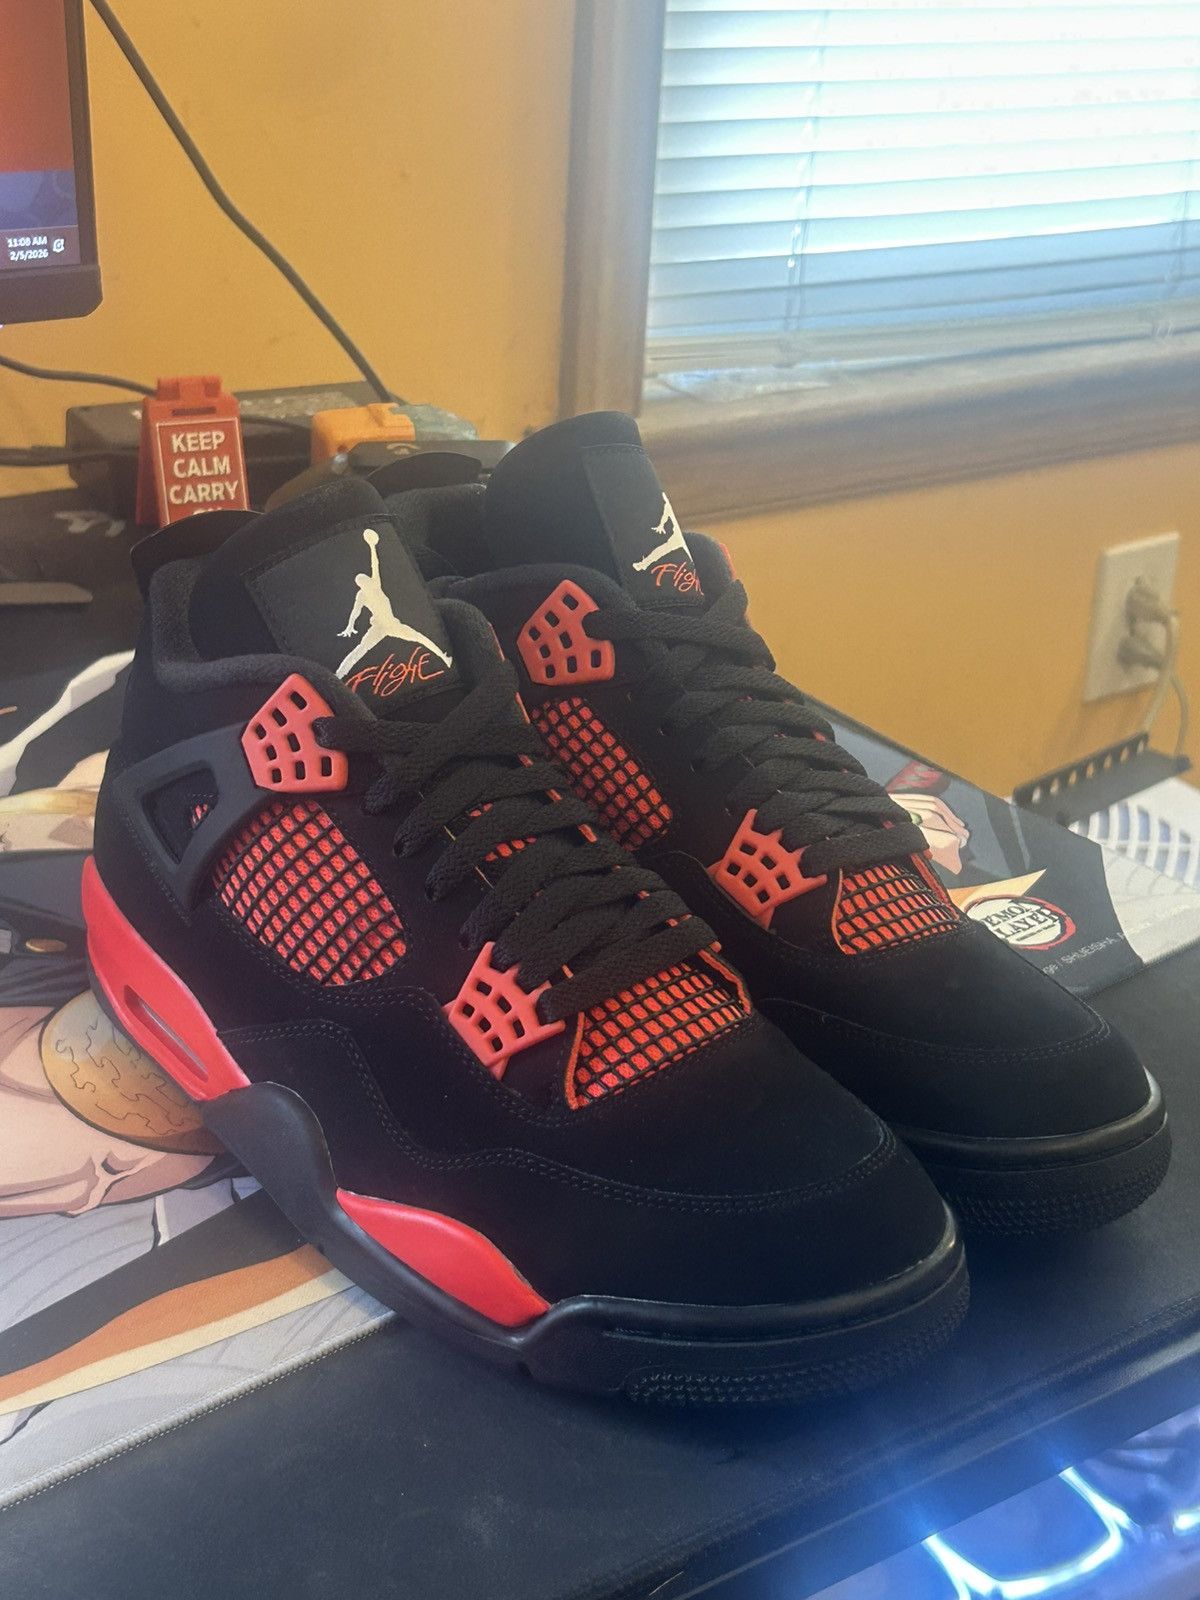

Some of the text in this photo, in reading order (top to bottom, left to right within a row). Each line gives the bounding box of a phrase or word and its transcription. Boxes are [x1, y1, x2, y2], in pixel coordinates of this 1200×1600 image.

[32, 235, 48, 246] AM
[171, 431, 225, 453] KEEP
[173, 455, 232, 478] CALM
[169, 480, 239, 504] CARRY
[344, 646, 444, 697] Flight
[994, 908, 1059, 938] LAYER
